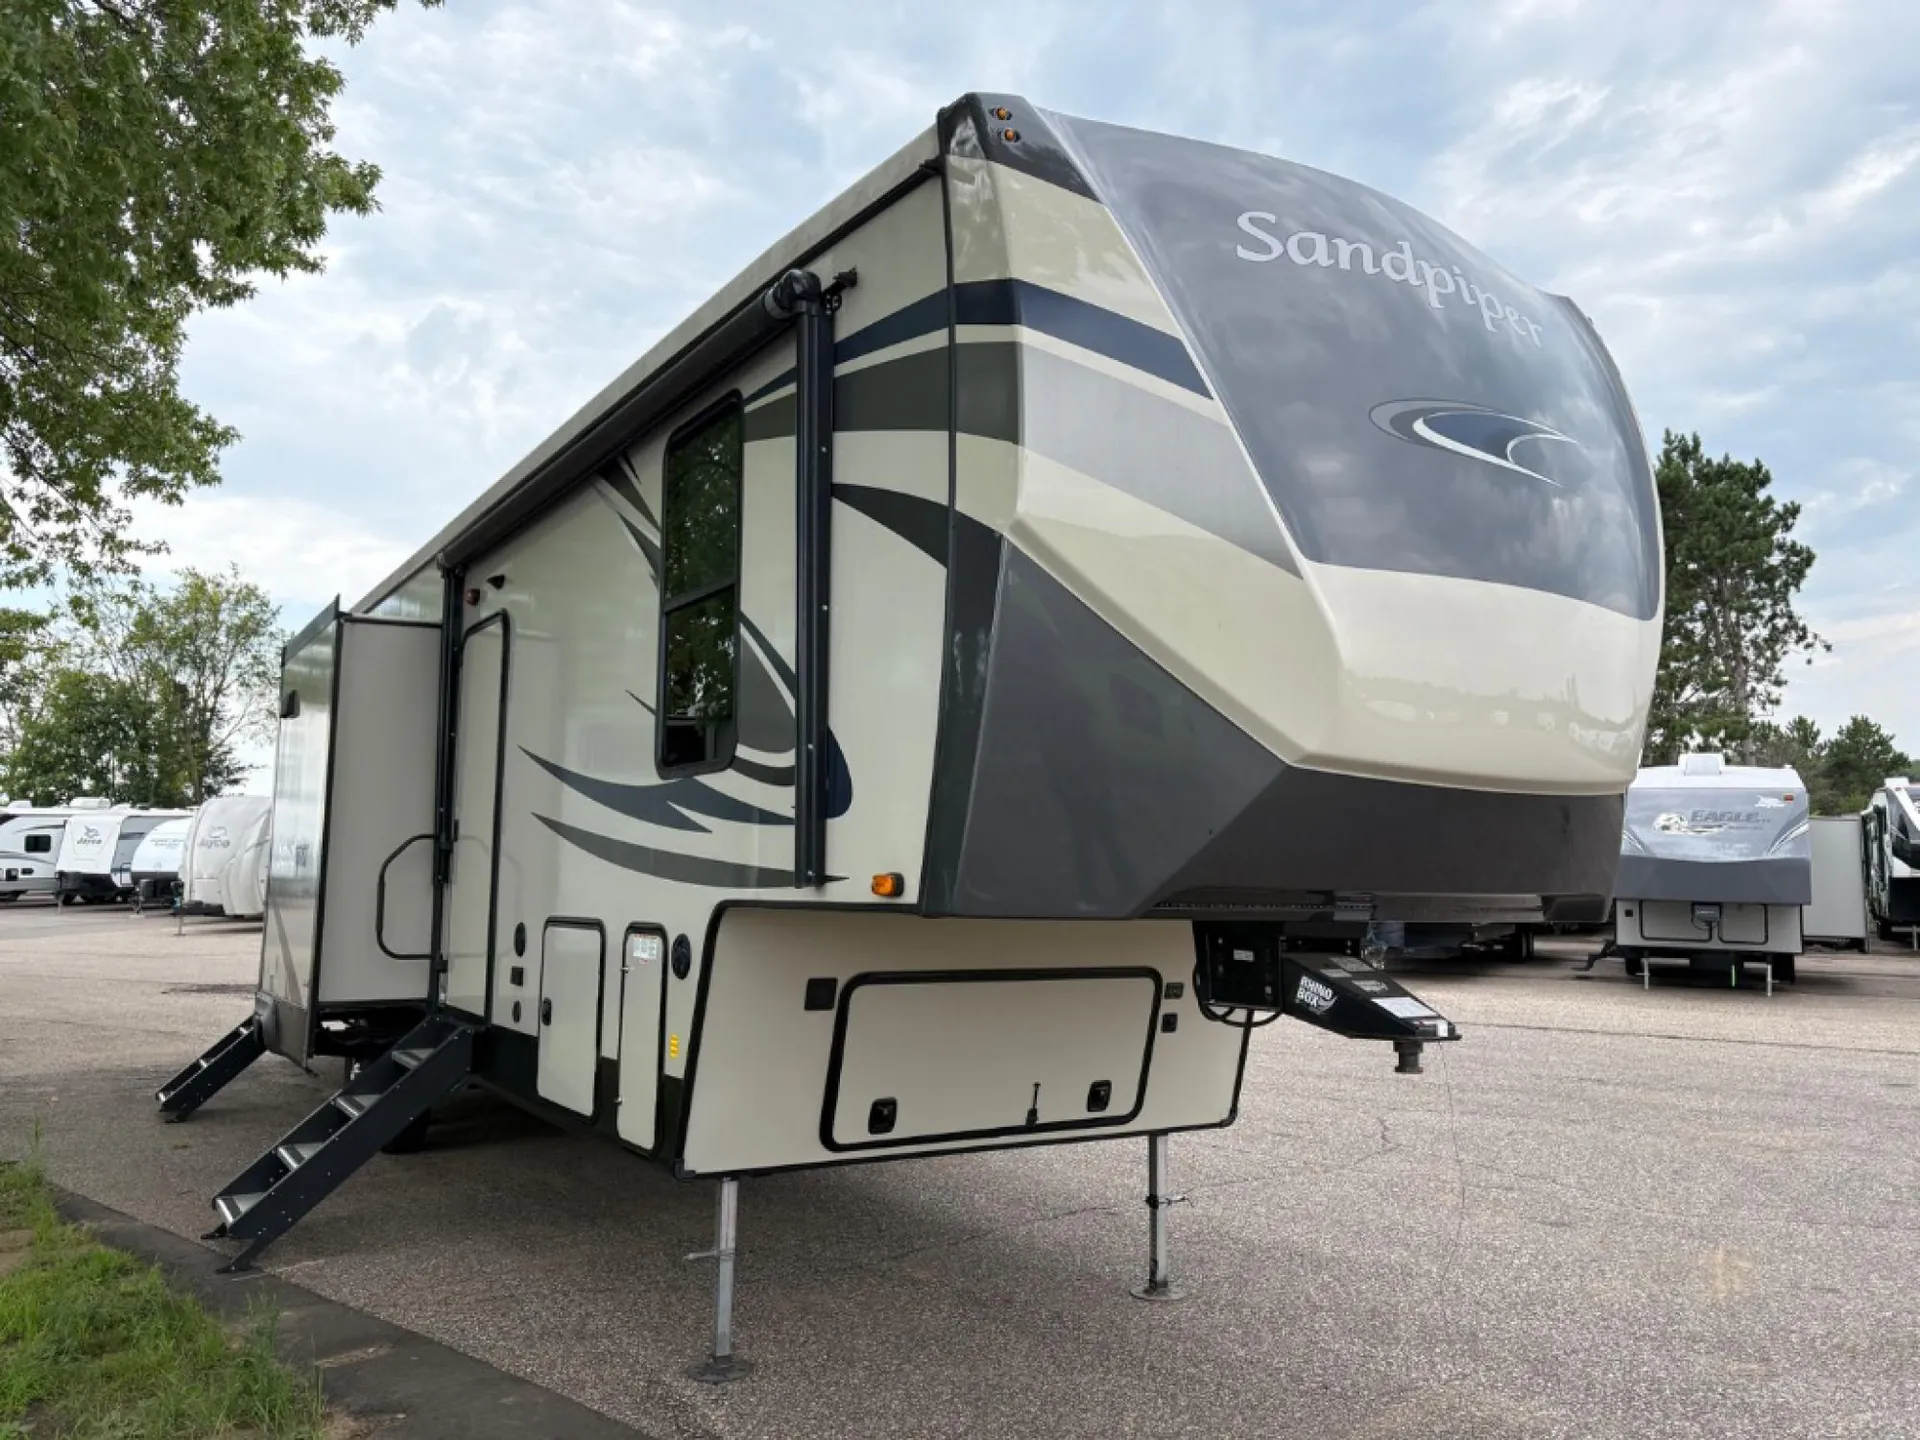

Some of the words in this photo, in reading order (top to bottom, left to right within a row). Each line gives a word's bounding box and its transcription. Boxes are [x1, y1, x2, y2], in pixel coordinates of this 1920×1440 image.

[1236, 211, 1544, 347] Sandpiper
[1297, 987, 1319, 1007] BOX
[1300, 975, 1333, 1000] RHINO
